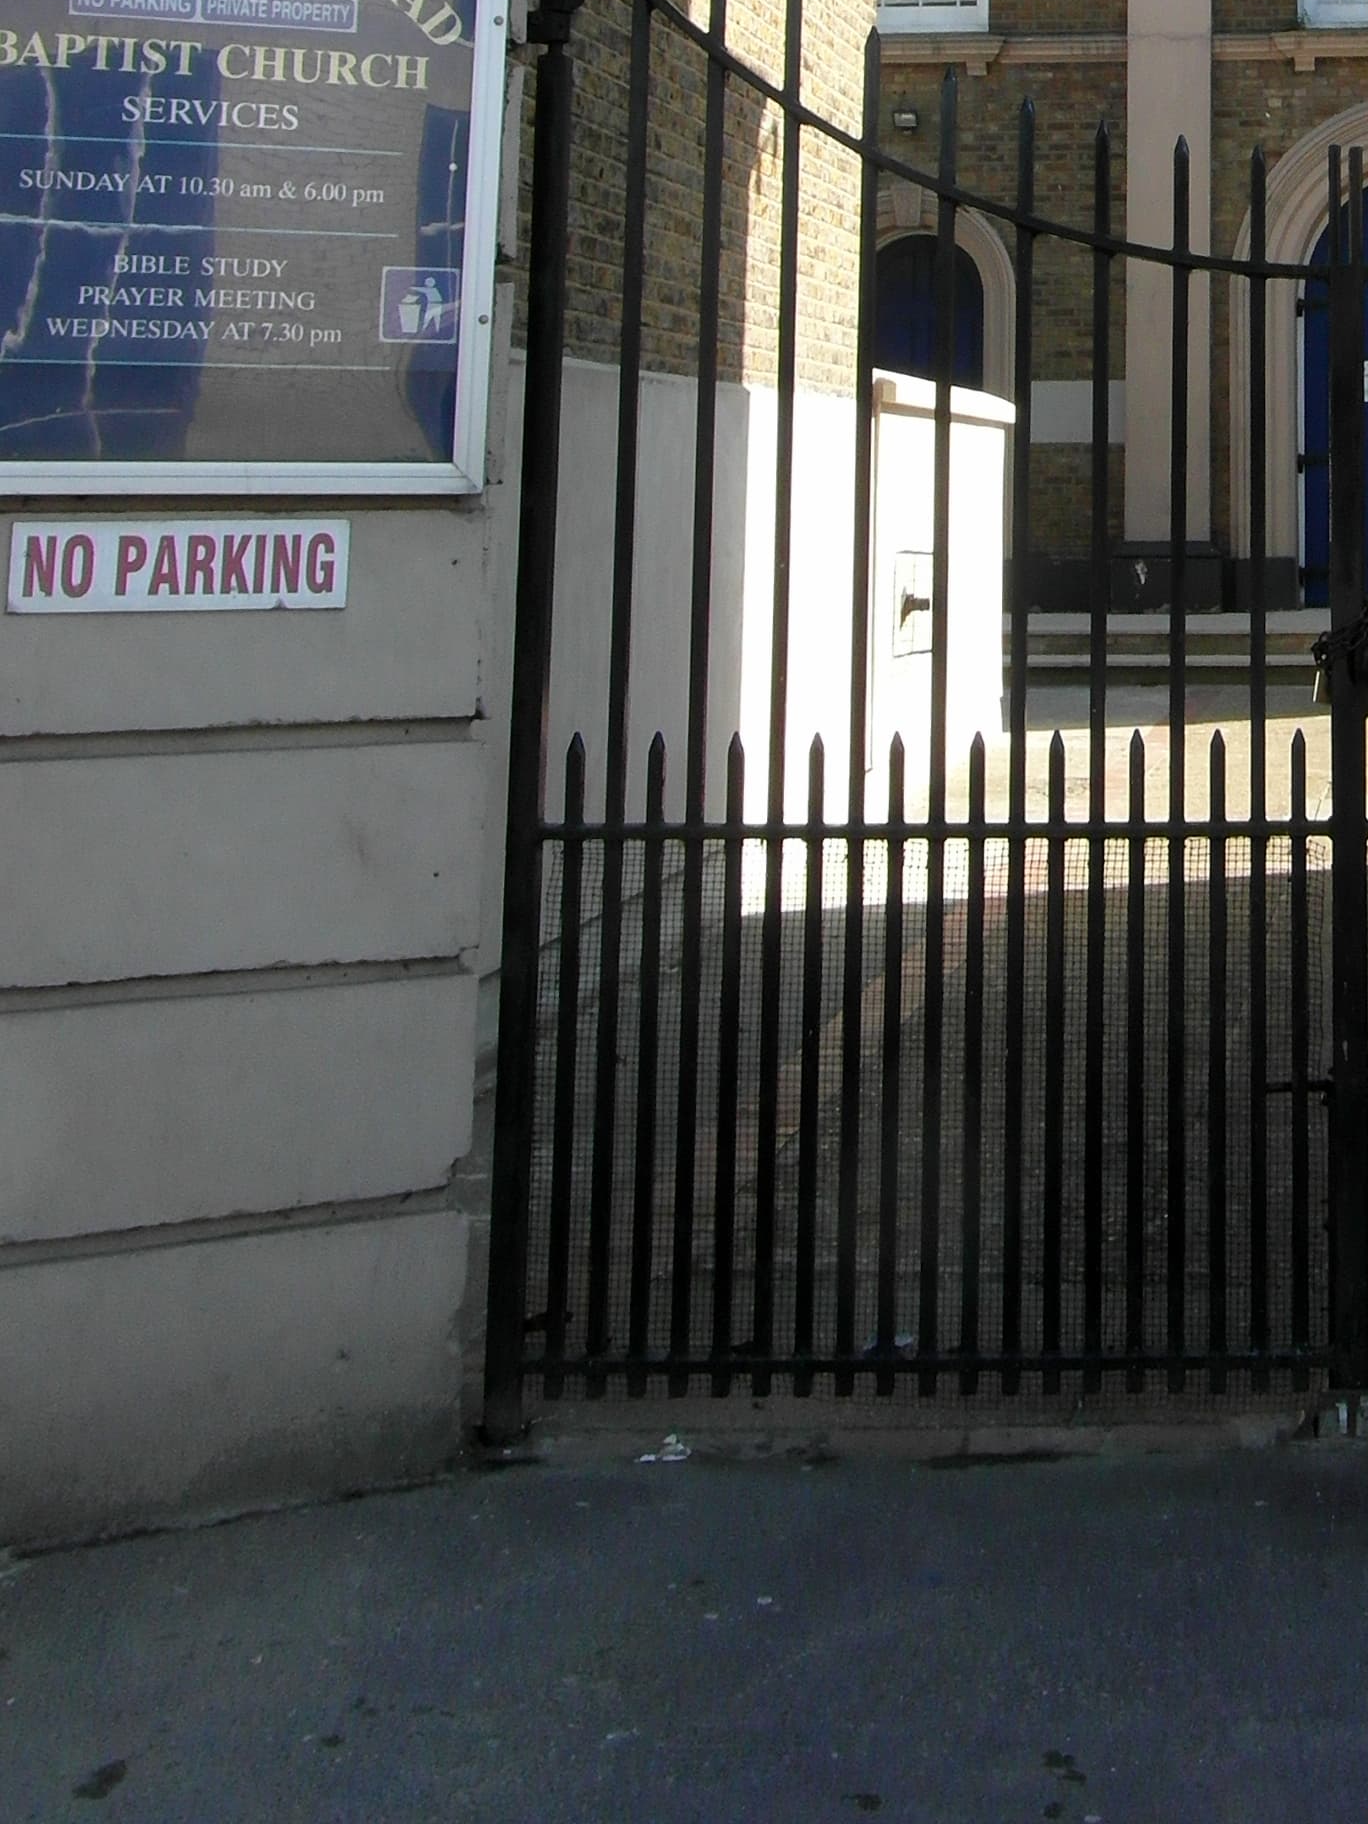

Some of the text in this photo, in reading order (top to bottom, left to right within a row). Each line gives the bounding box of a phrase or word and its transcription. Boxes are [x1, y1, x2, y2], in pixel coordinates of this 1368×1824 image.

[271, 0, 350, 23] PROPERTY
[216, 43, 430, 90] CHURCH
[121, 95, 299, 131] SERVICES
[19, 168, 385, 208] SUNDAY AT 10.30 am & 6.00 pm
[113, 254, 288, 278] BIBLE STUDY
[77, 285, 316, 311] PRAYER MEETING
[46, 317, 342, 347] WEDNESDAY AT 7.30 pm
[22, 533, 336, 598] NO PARKING
